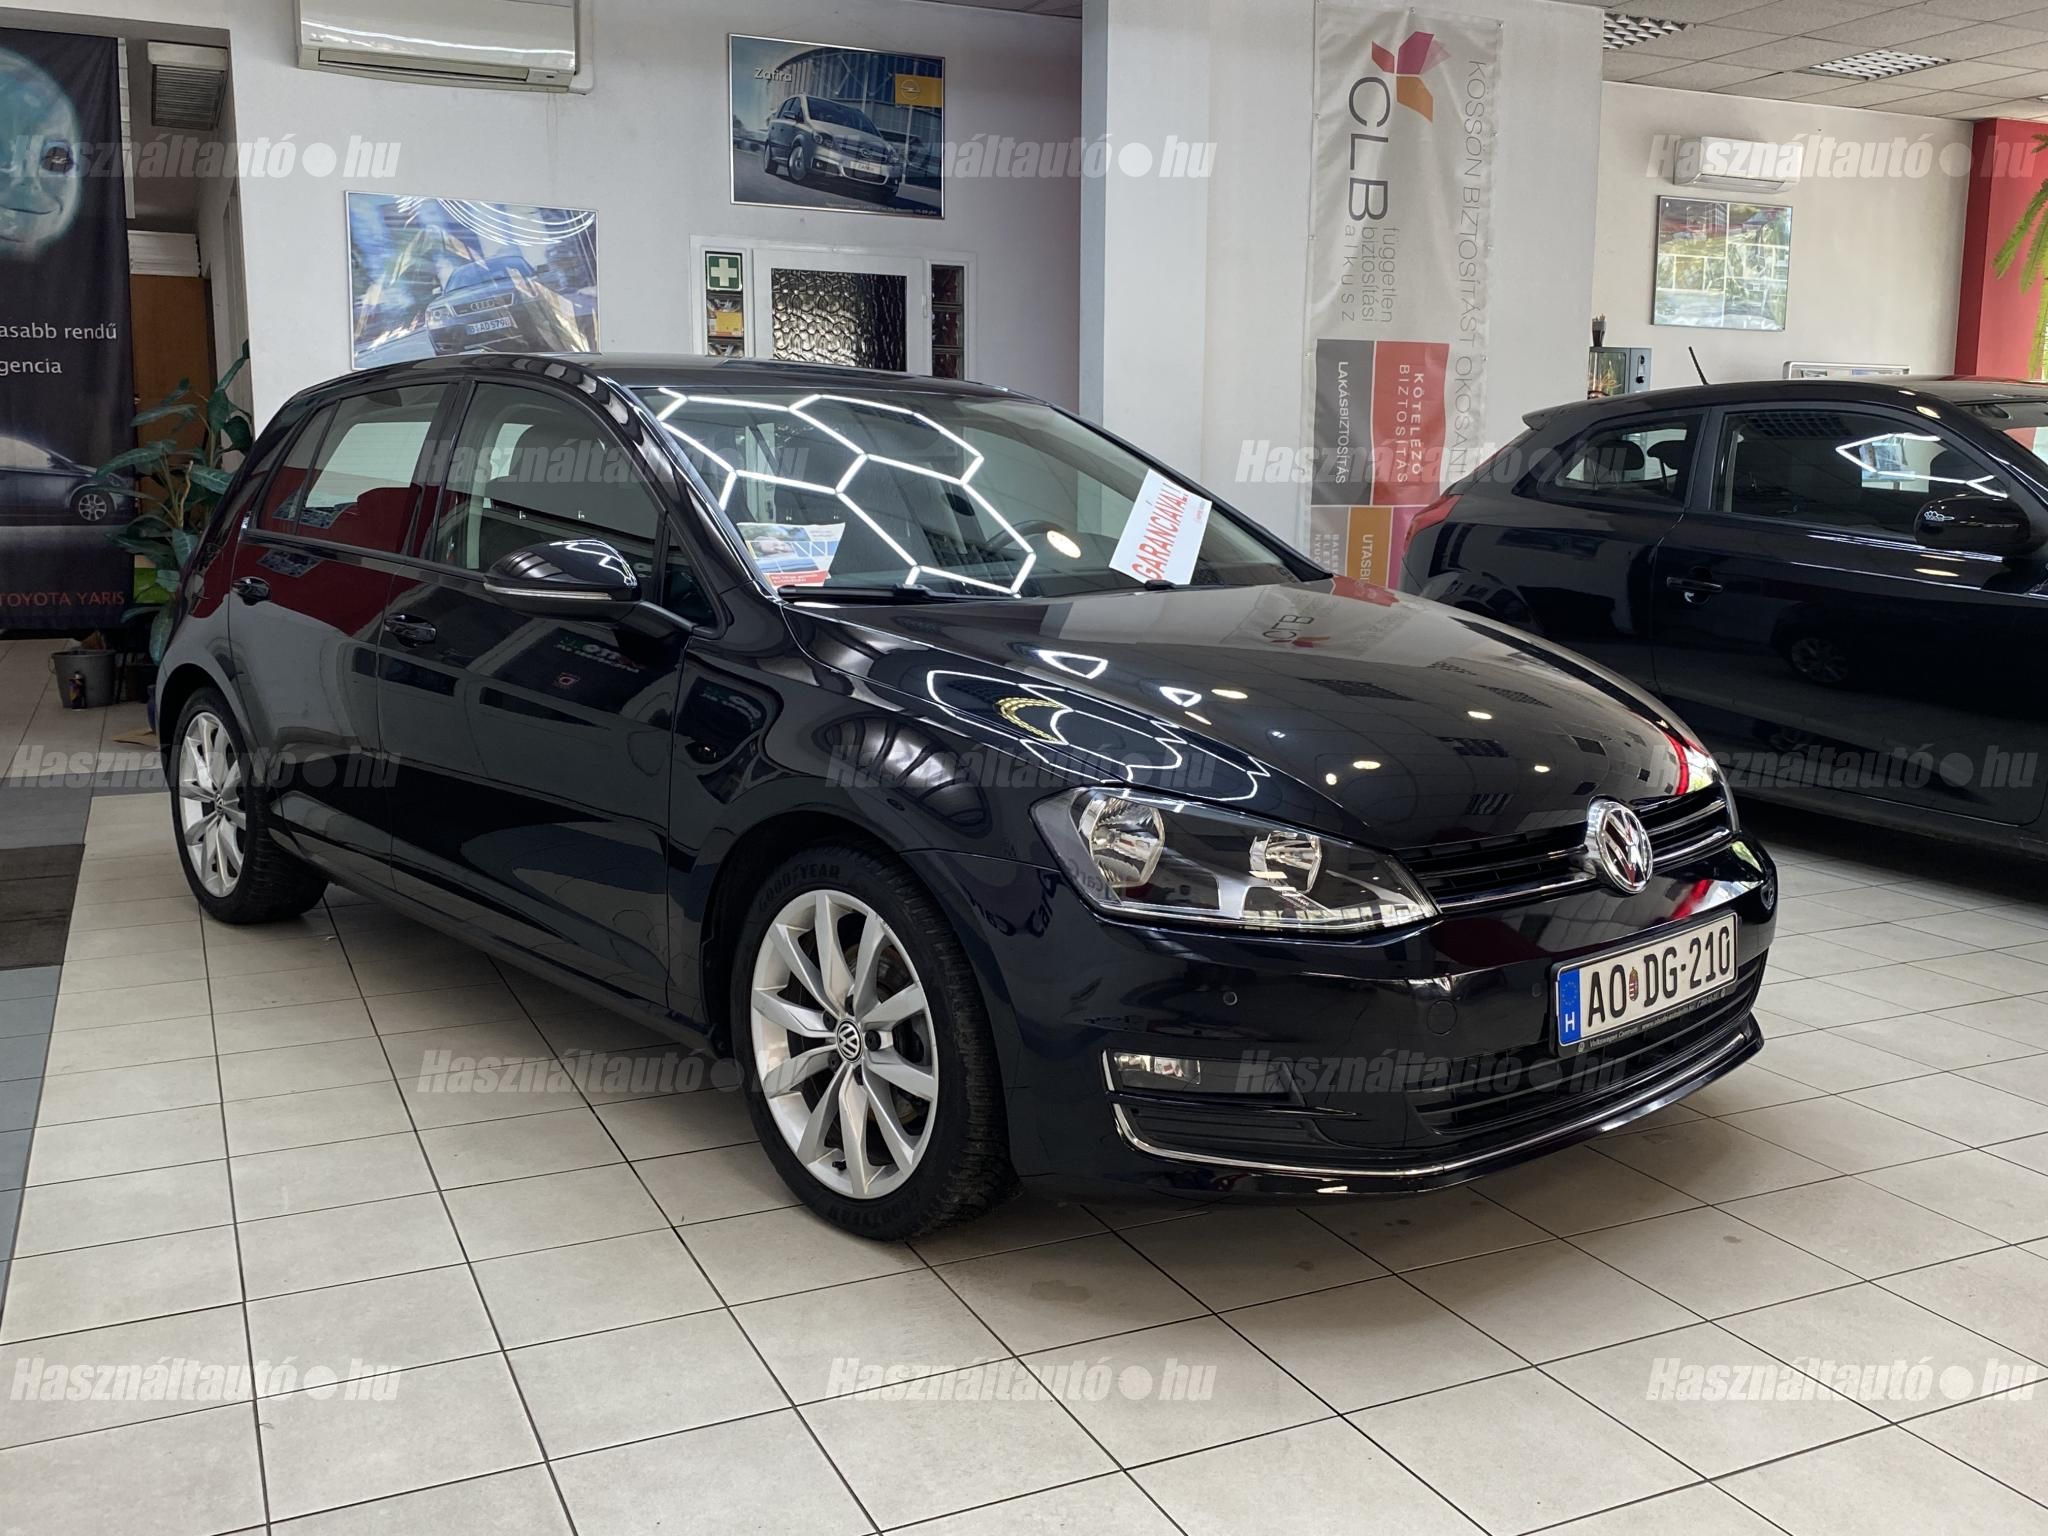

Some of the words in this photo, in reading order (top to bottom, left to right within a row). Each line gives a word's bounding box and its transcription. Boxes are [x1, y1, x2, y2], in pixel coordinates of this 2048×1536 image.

[754, 67, 793, 83] Zafira
[1463, 60, 1489, 177] KÖSSÖN
[1349, 76, 1391, 222] CLB
[1341, 225, 1357, 323] alkusz
[1361, 226, 1379, 323] biztosítási
[1379, 225, 1400, 323] független
[0, 358, 63, 377] gencia
[64, 322, 117, 340] rendű
[1394, 364, 1410, 483] BIZTOSÍTÁS
[0, 592, 72, 607] TOYOTA
[77, 591, 125, 606] YARIS
[1359, 534, 1374, 581] UTASBI
[1565, 1012, 1576, 1033] H
[1588, 964, 1627, 1028] AO
[1643, 925, 1731, 1008] DG-210
